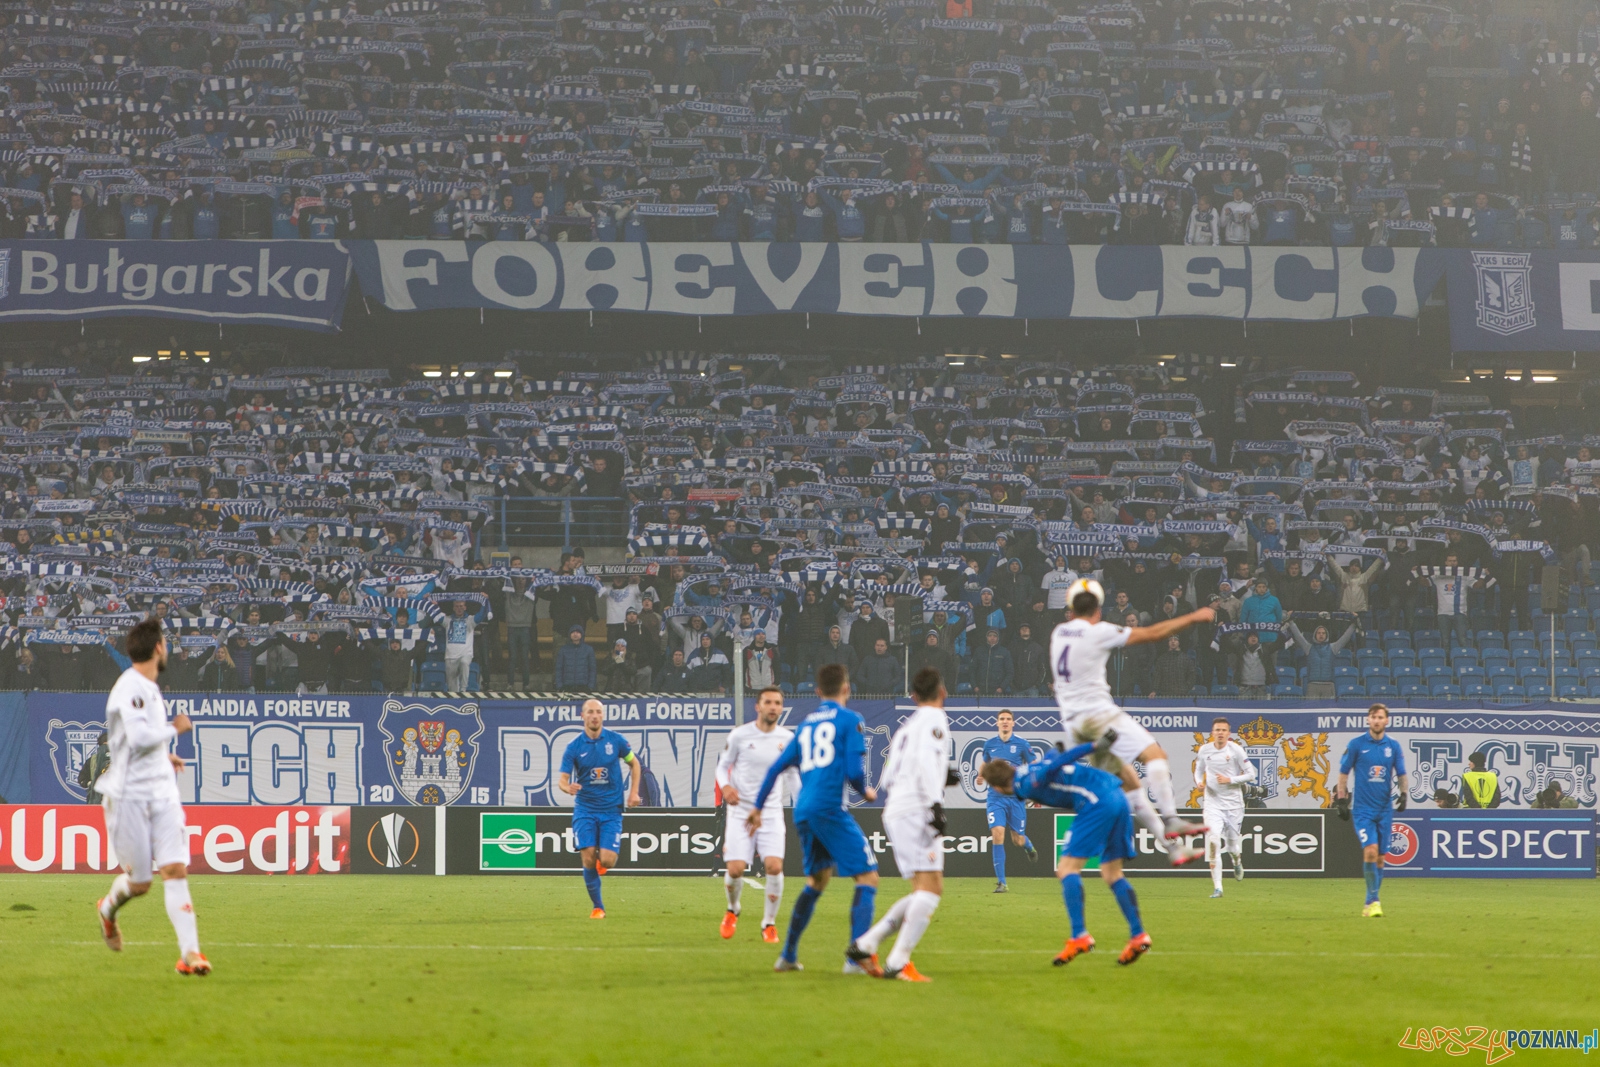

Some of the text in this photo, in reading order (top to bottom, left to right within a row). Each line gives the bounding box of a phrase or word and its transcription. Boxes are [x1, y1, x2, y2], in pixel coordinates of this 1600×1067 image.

[1480, 256, 1524, 266] KKS LECH
[19, 247, 331, 302] Bułgarska
[374, 240, 1420, 319] FOREVER LECH
[835, 476, 893, 486] KOLEJORZ
[285, 499, 338, 509] OLEJORZ
[1094, 523, 1155, 535] SZAMOTU
[1166, 520, 1229, 532] SZAMOTUŁY
[1422, 517, 1451, 527] ECH
[1262, 550, 1324, 561] KOLEJOR
[450, 567, 511, 577] ANATYCY
[1222, 621, 1281, 633] Lech 1922
[1058, 645, 1072, 683] 4
[164, 699, 351, 718] YRLANDIA FOREVER
[533, 702, 733, 722] PYRLNDIA FOREVER
[1317, 716, 1436, 729] MY NIEUBIANI
[69, 732, 81, 740] KKS
[798, 721, 837, 773] 18
[370, 784, 394, 803] 20
[471, 786, 490, 804] 15
[1359, 828, 1368, 843] 5
[1390, 824, 1411, 836] EFA
[11, 809, 342, 872] Unredit
[481, 825, 722, 862] entrpris
[1432, 829, 1591, 859] RESPECT
